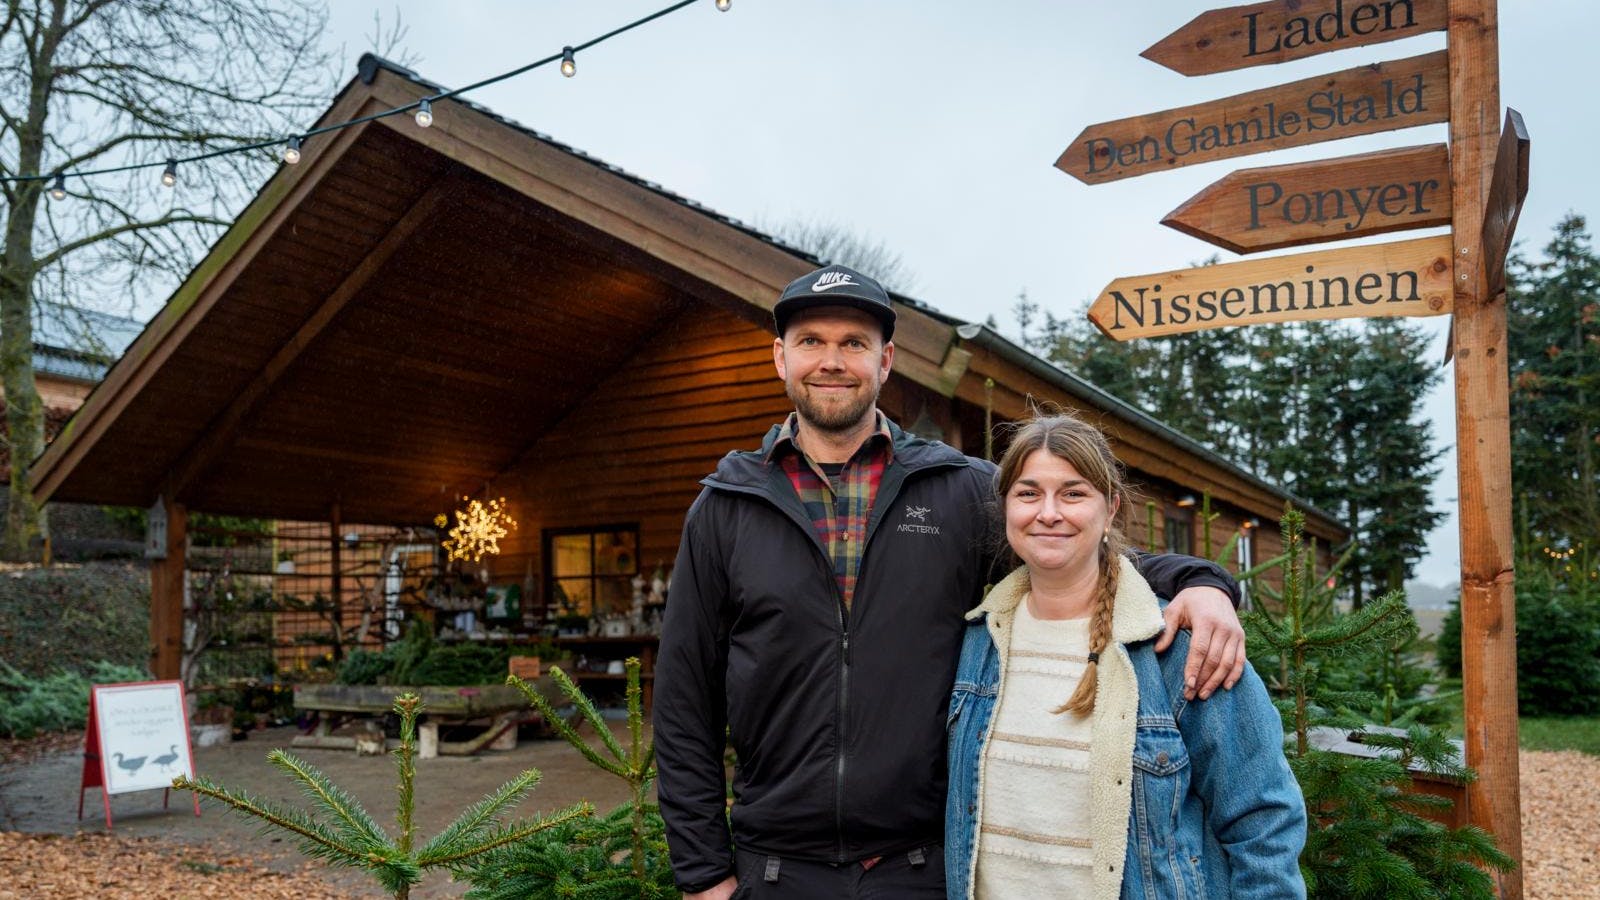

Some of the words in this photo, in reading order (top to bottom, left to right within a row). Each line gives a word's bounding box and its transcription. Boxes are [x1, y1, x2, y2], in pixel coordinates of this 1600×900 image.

[1242, 0, 1419, 57] Laden
[1084, 135, 1163, 175] Den
[1165, 102, 1302, 156] Gamle
[1307, 74, 1429, 132] Stald
[1243, 178, 1439, 232] Ponyer
[817, 271, 852, 284] NIKE
[1108, 265, 1422, 330] Nisseminen
